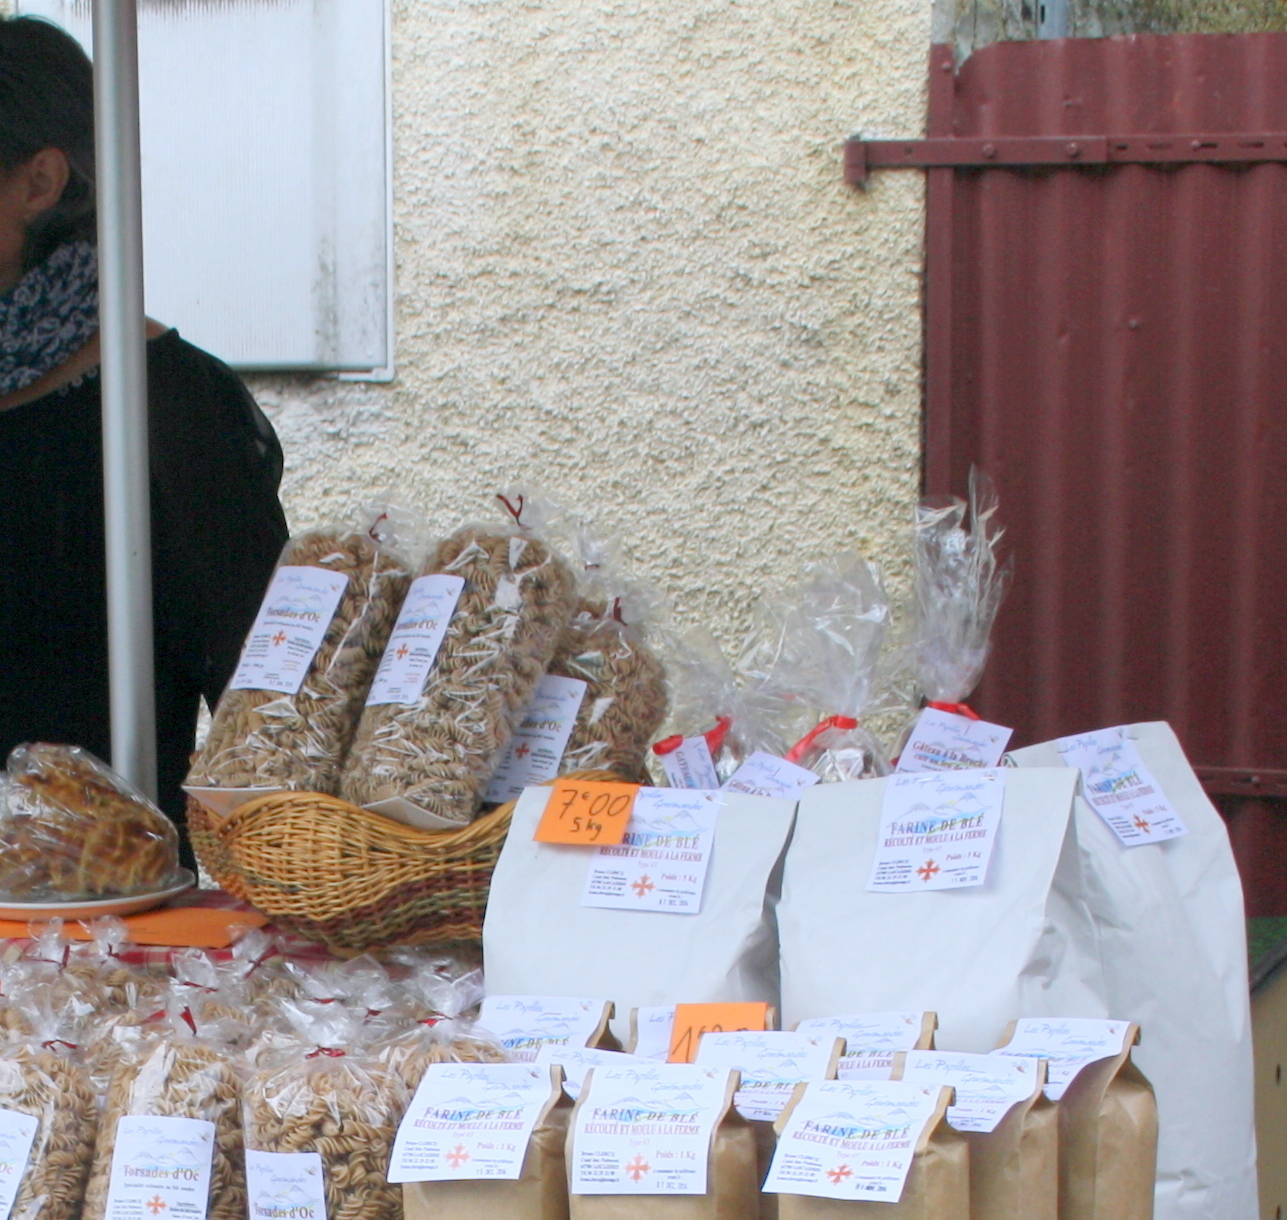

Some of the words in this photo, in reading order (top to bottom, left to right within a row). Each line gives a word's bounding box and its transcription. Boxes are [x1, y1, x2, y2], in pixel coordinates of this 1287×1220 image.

[569, 817, 582, 833] 5
[585, 817, 603, 841] kg
[891, 821, 935, 835] FARINE
[940, 819, 956, 831] DE
[961, 812, 985, 828] BLÉ
[621, 832, 651, 847] RINE
[656, 834, 672, 847] DE
[676, 834, 701, 850] BLÉ
[423, 1107, 475, 1121] FARINE
[476, 1109, 494, 1120] DE
[497, 1106, 525, 1120] BLÉ
[592, 1108, 645, 1122] FARINE
[646, 1112, 668, 1122] DE
[669, 1111, 700, 1124] BLÉ
[413, 1118, 447, 1130] RÉCOLTÉ
[498, 1121, 525, 1131] FERME
[584, 1122, 619, 1135] RÉCOLTÉ
[620, 1124, 630, 1135] ET
[630, 1123, 656, 1135] MOULU
[673, 1125, 701, 1135] FERME
[803, 1120, 857, 1139] FARINE
[862, 1129, 880, 1139] DE
[884, 1124, 910, 1139] BLÉ
[792, 1130, 829, 1145] RÉCOLTÉ
[828, 1137, 839, 1147] ET
[655, 1150, 674, 1159] Poids
[685, 1151, 696, 1161] Kg
[123, 1165, 169, 1178] Torsades
[892, 1161, 903, 1170] Kg
